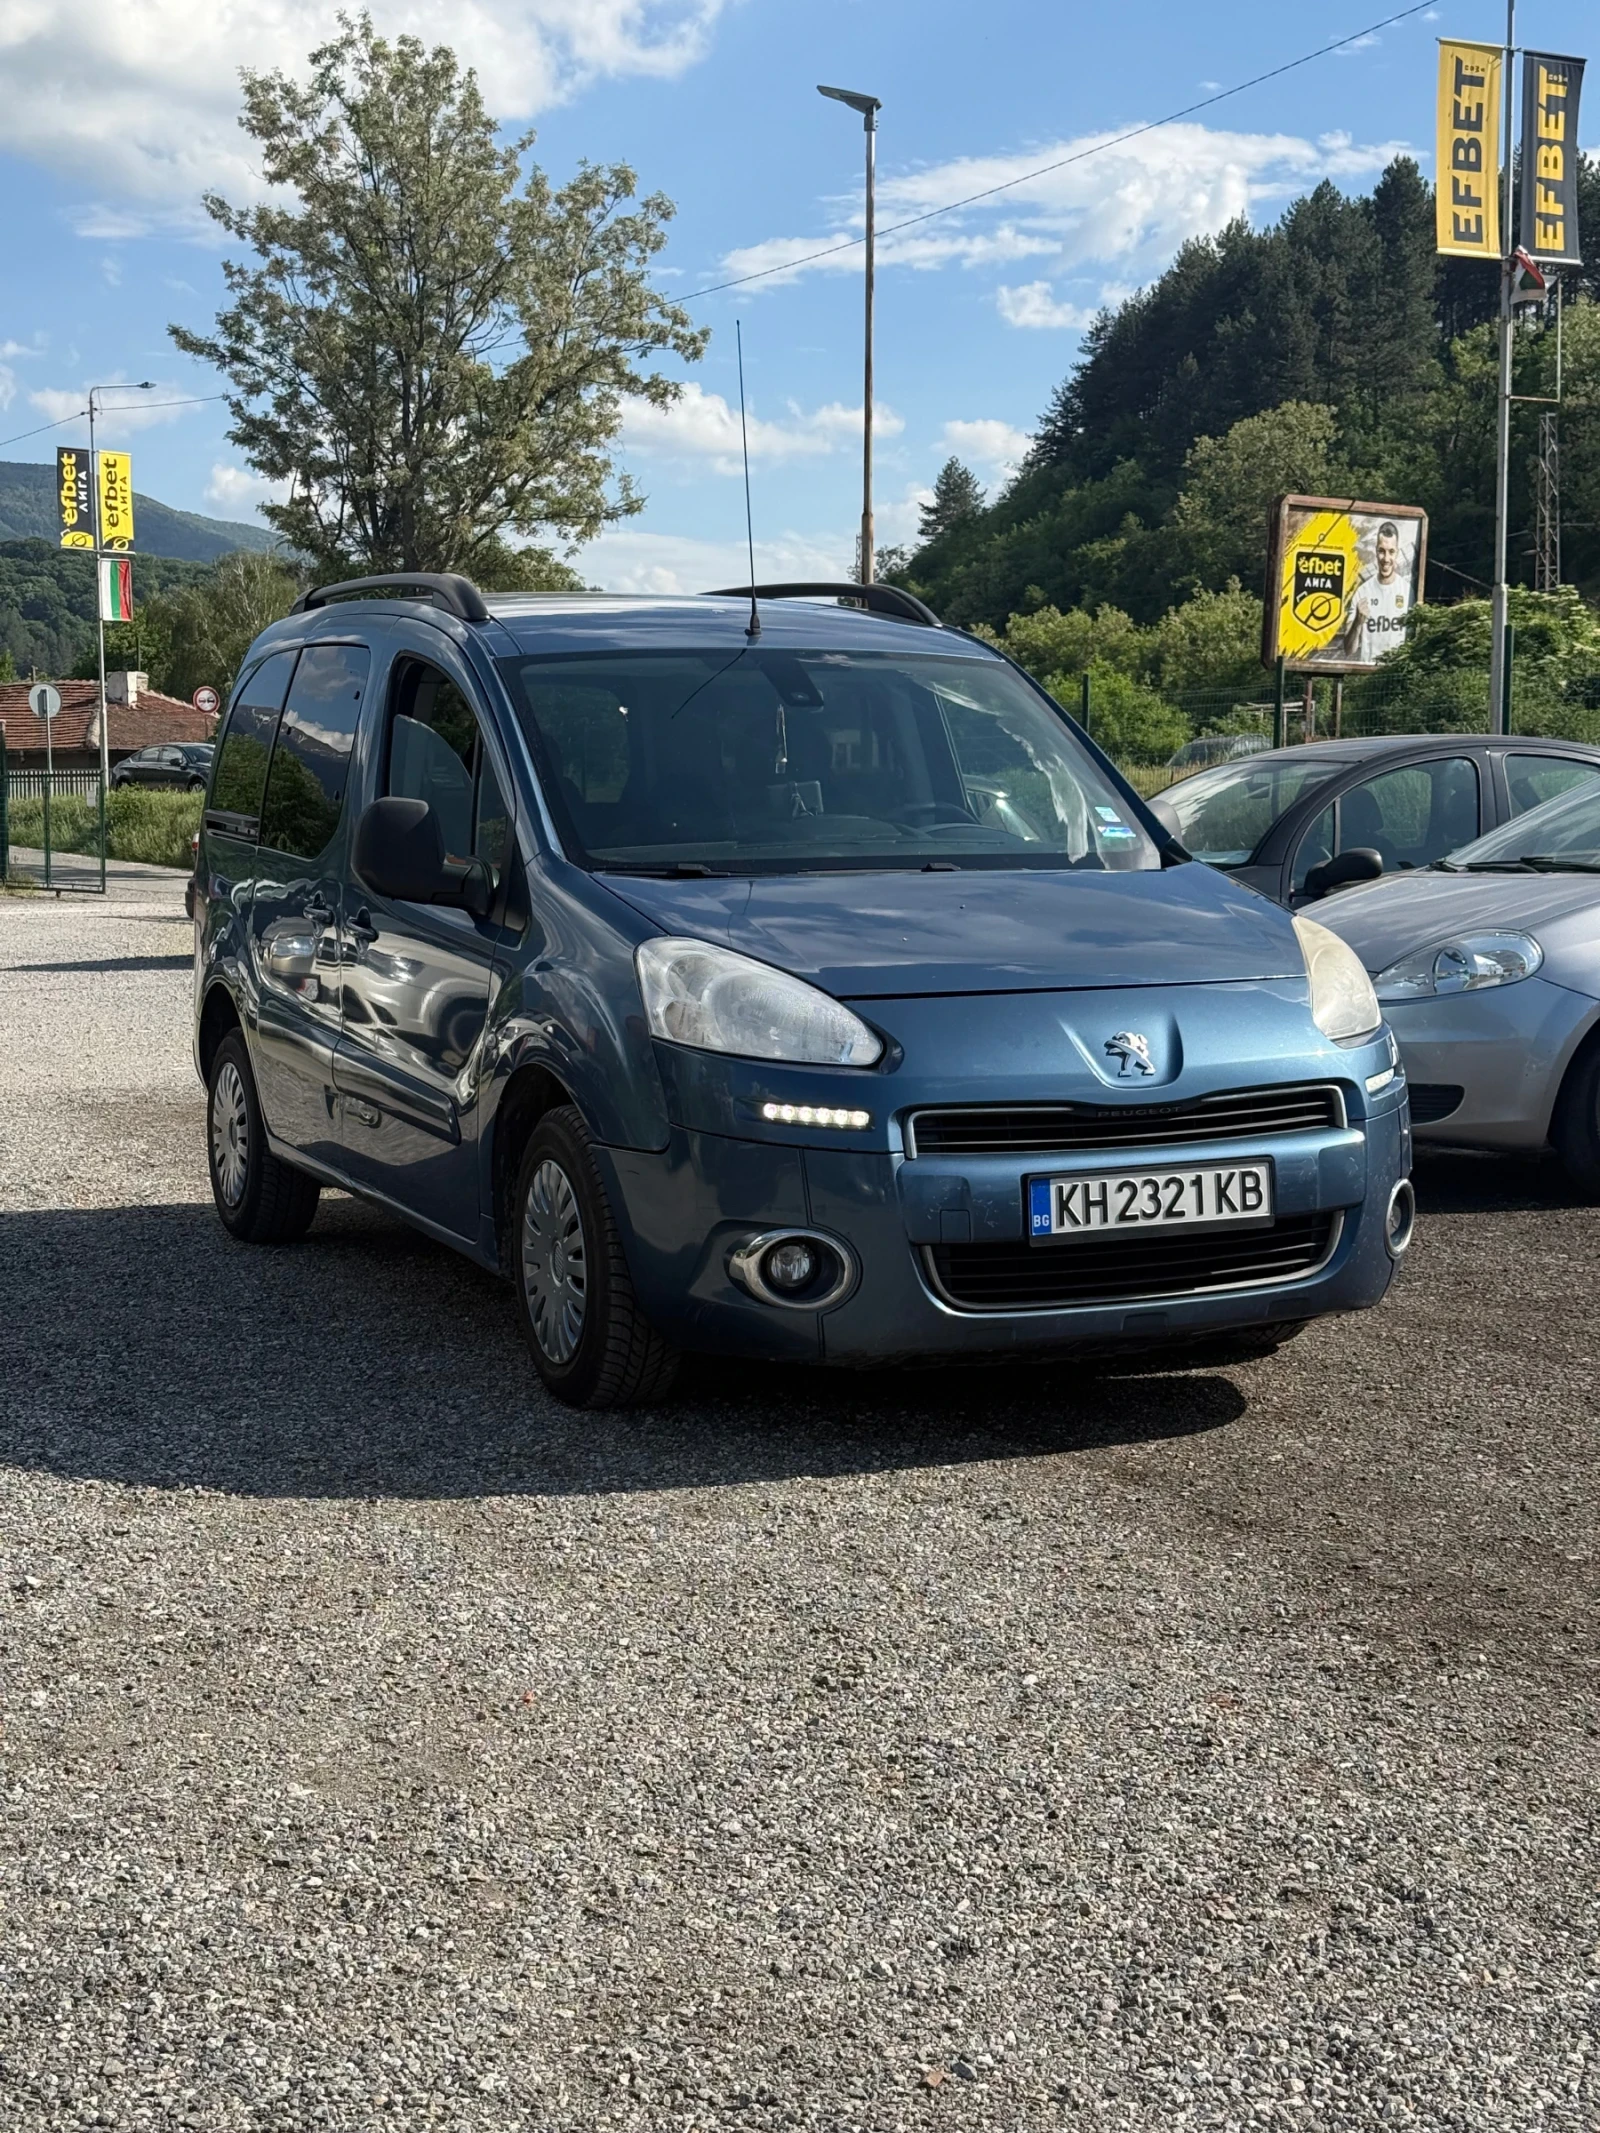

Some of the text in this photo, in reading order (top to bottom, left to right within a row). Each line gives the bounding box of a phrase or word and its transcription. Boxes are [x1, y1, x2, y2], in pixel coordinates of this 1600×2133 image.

[1452, 56, 1485, 243] EFBET
[1535, 65, 1567, 250] EFBET
[78, 471, 88, 513] ЛИГА
[120, 476, 128, 516] ЛИГА
[1304, 577, 1333, 589] ЛИГА
[1097, 1106, 1181, 1118] PEUGEOT
[1033, 1215, 1050, 1228] BG
